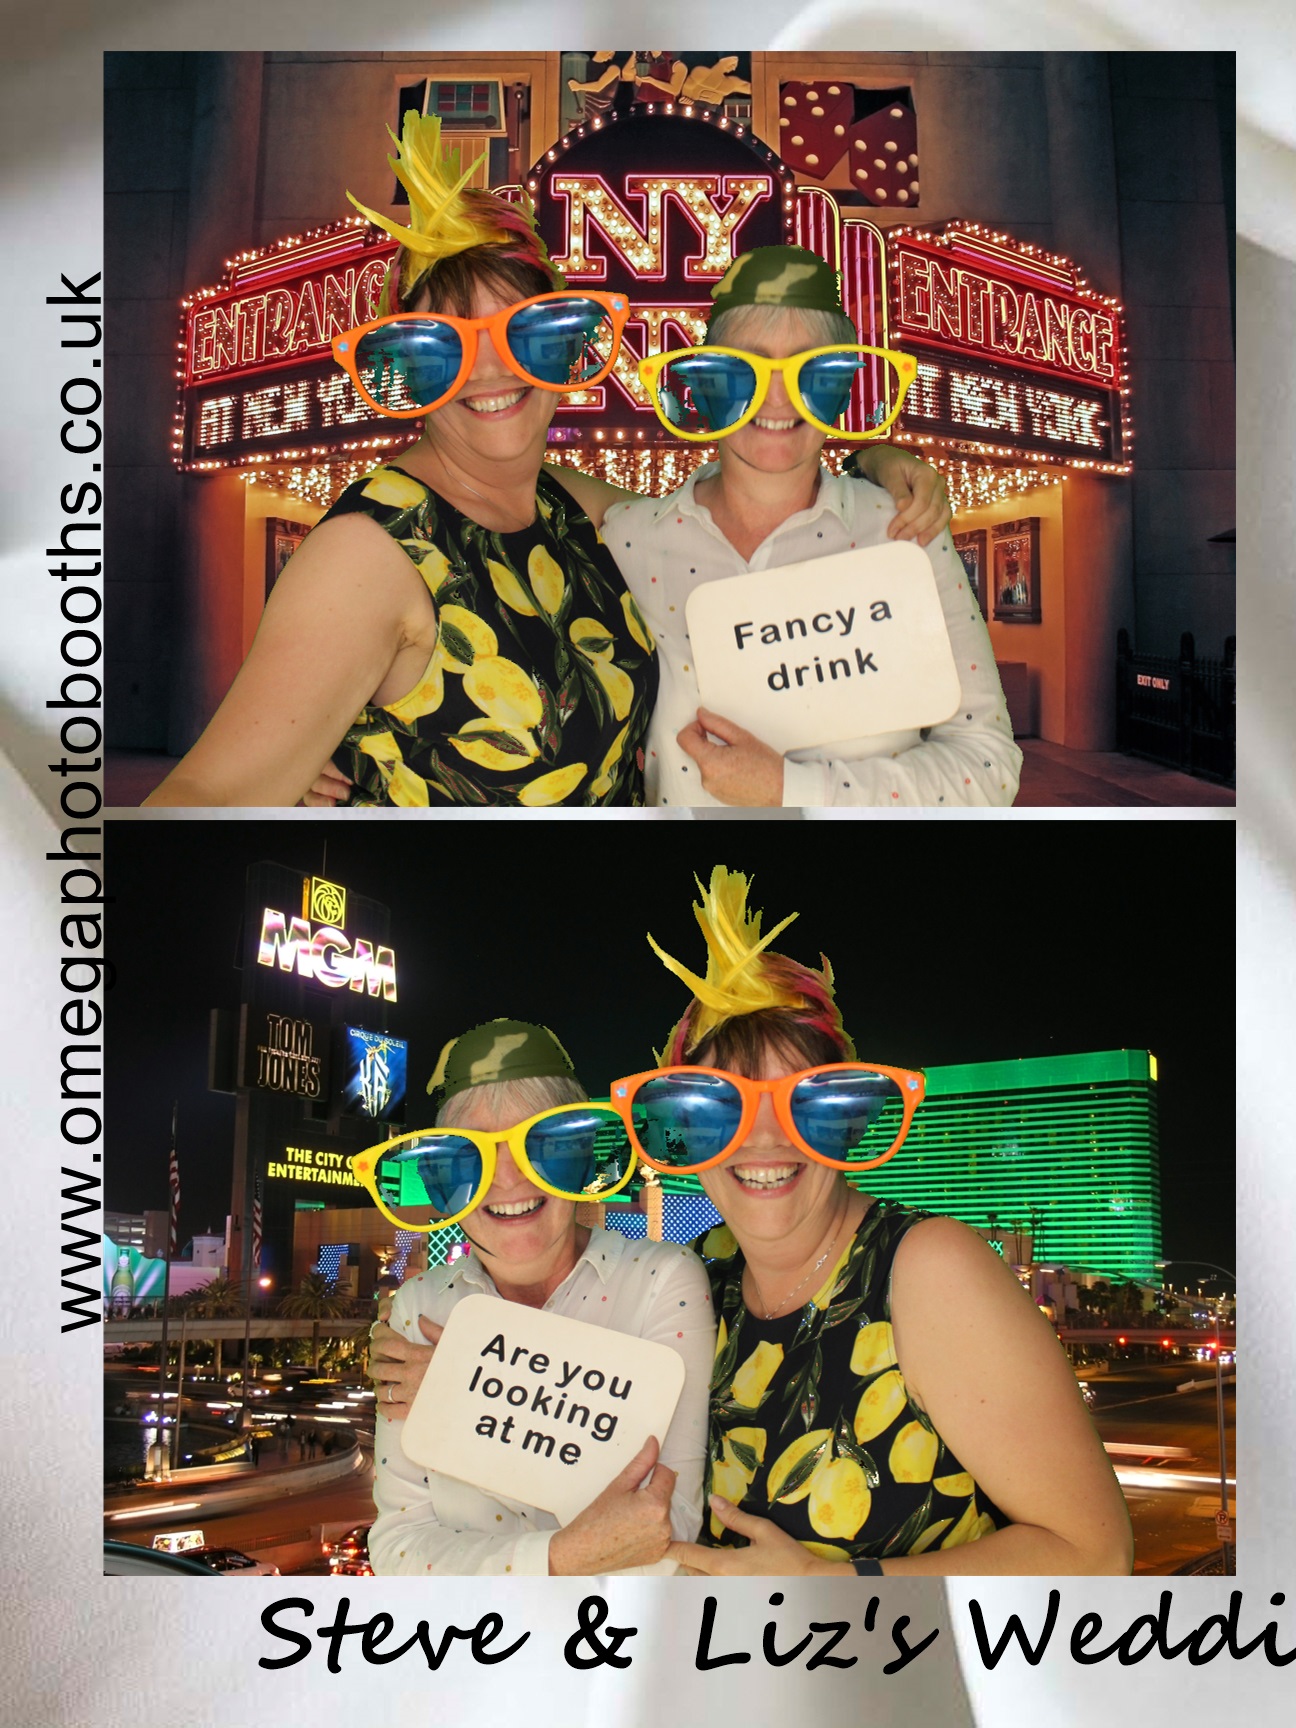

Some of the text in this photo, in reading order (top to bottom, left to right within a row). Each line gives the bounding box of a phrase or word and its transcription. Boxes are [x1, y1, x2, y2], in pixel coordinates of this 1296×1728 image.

[551, 174, 773, 282] NY
[192, 256, 396, 374] ENTRANC
[899, 250, 1115, 378] ENTRANCE
[734, 601, 892, 650] Fancy a
[767, 648, 878, 691] drink
[1137, 674, 1169, 690] EXIT ONLY
[257, 907, 398, 1003] MGM
[267, 1013, 314, 1058] TOM
[350, 1028, 374, 1042] CIRQUE
[257, 1051, 322, 1098] JONES
[286, 1146, 312, 1164] THE
[315, 1151, 344, 1168] CITY
[480, 1333, 632, 1400] Are you
[469, 1365, 618, 1442] looking
[475, 1415, 581, 1466] at me
